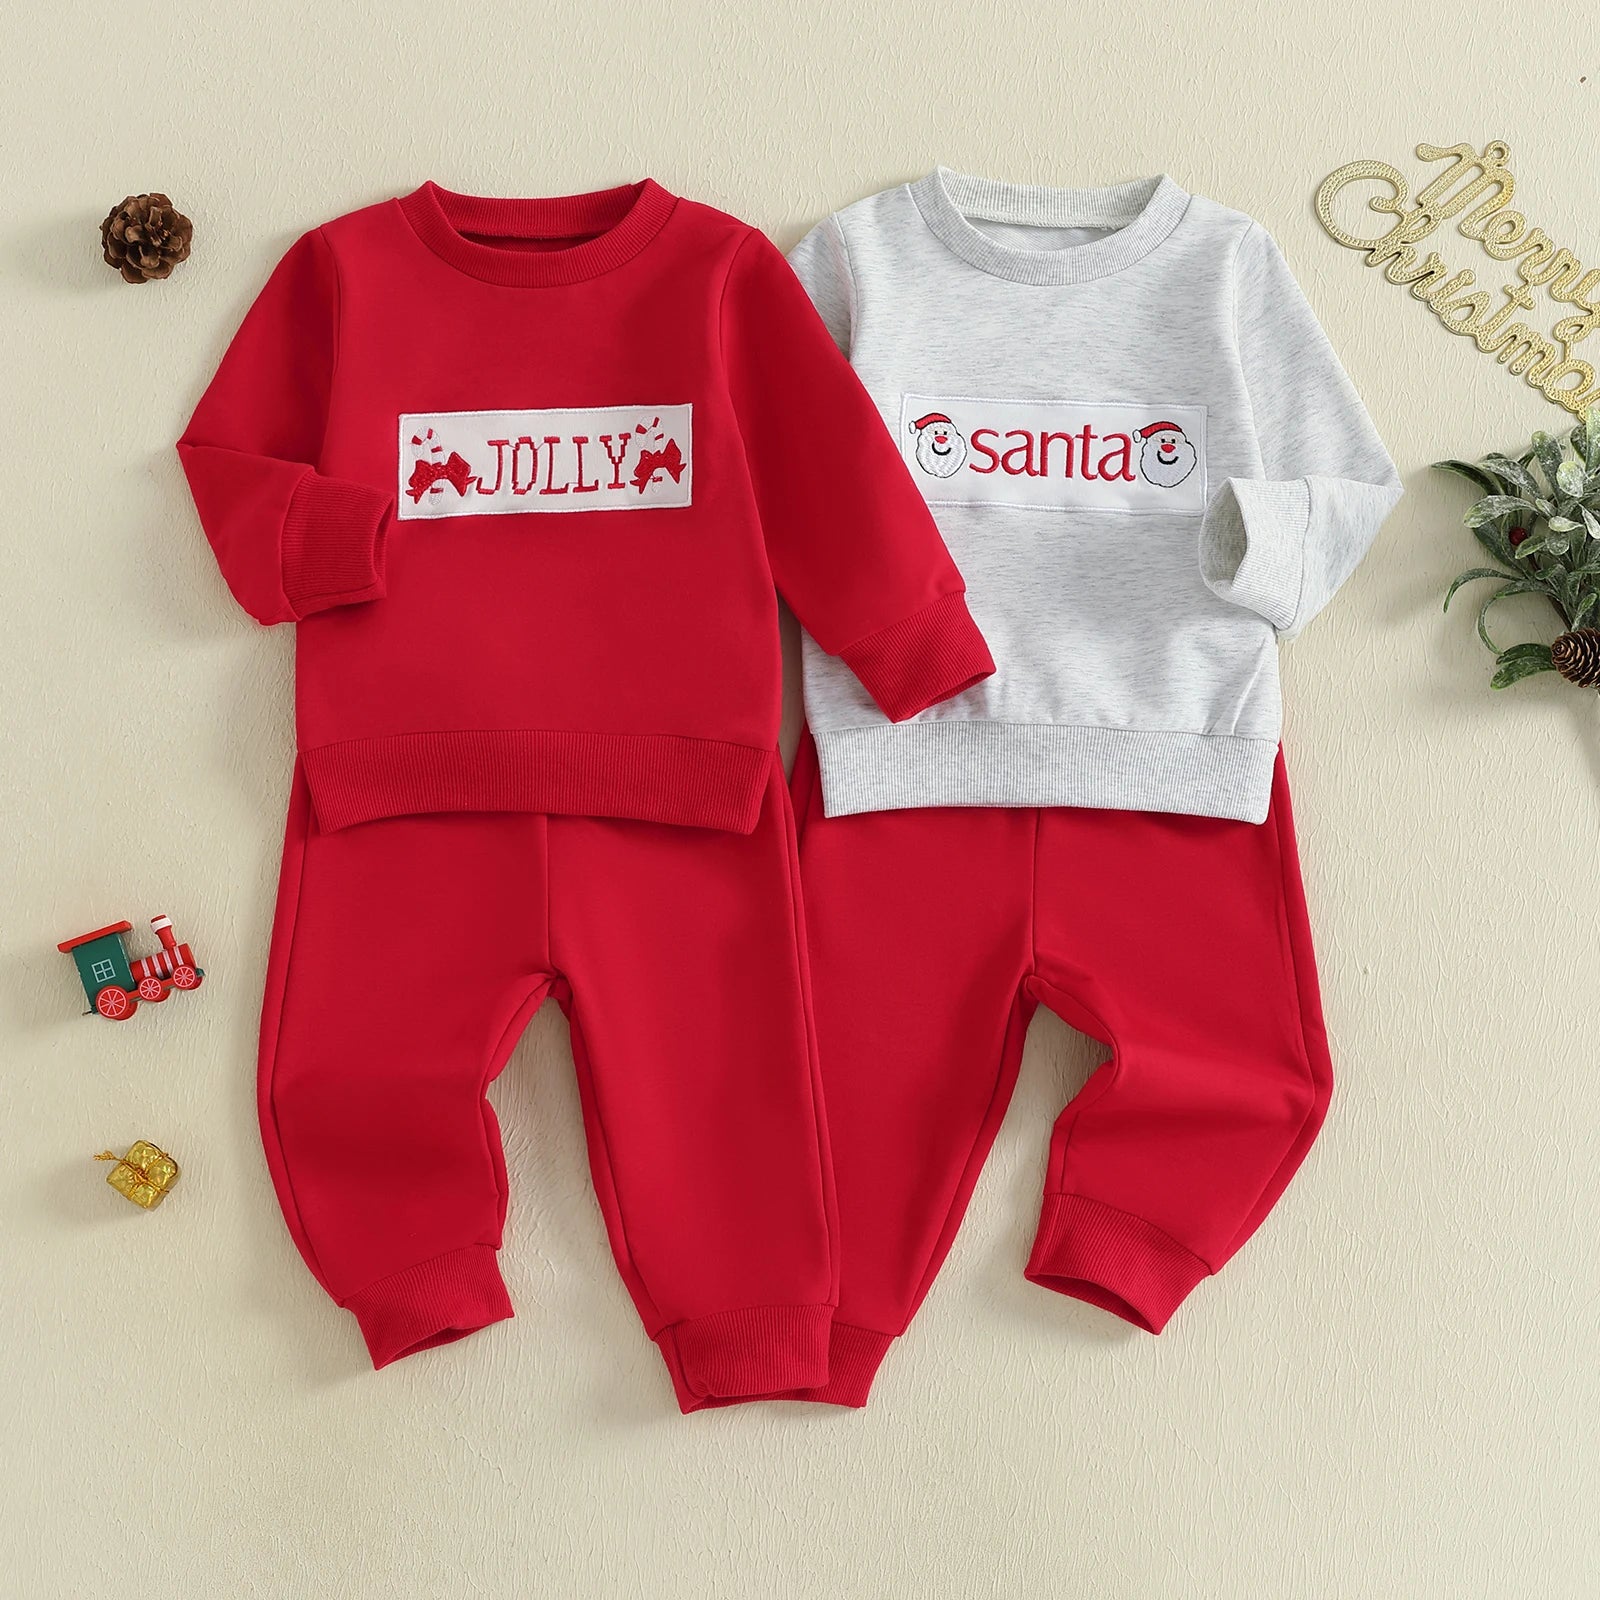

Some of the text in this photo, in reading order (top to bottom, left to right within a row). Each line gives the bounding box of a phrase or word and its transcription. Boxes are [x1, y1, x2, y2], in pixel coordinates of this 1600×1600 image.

[1315, 160, 1600, 423] Christma
[476, 432, 631, 495] JOLLY
[969, 423, 1136, 482] santa
